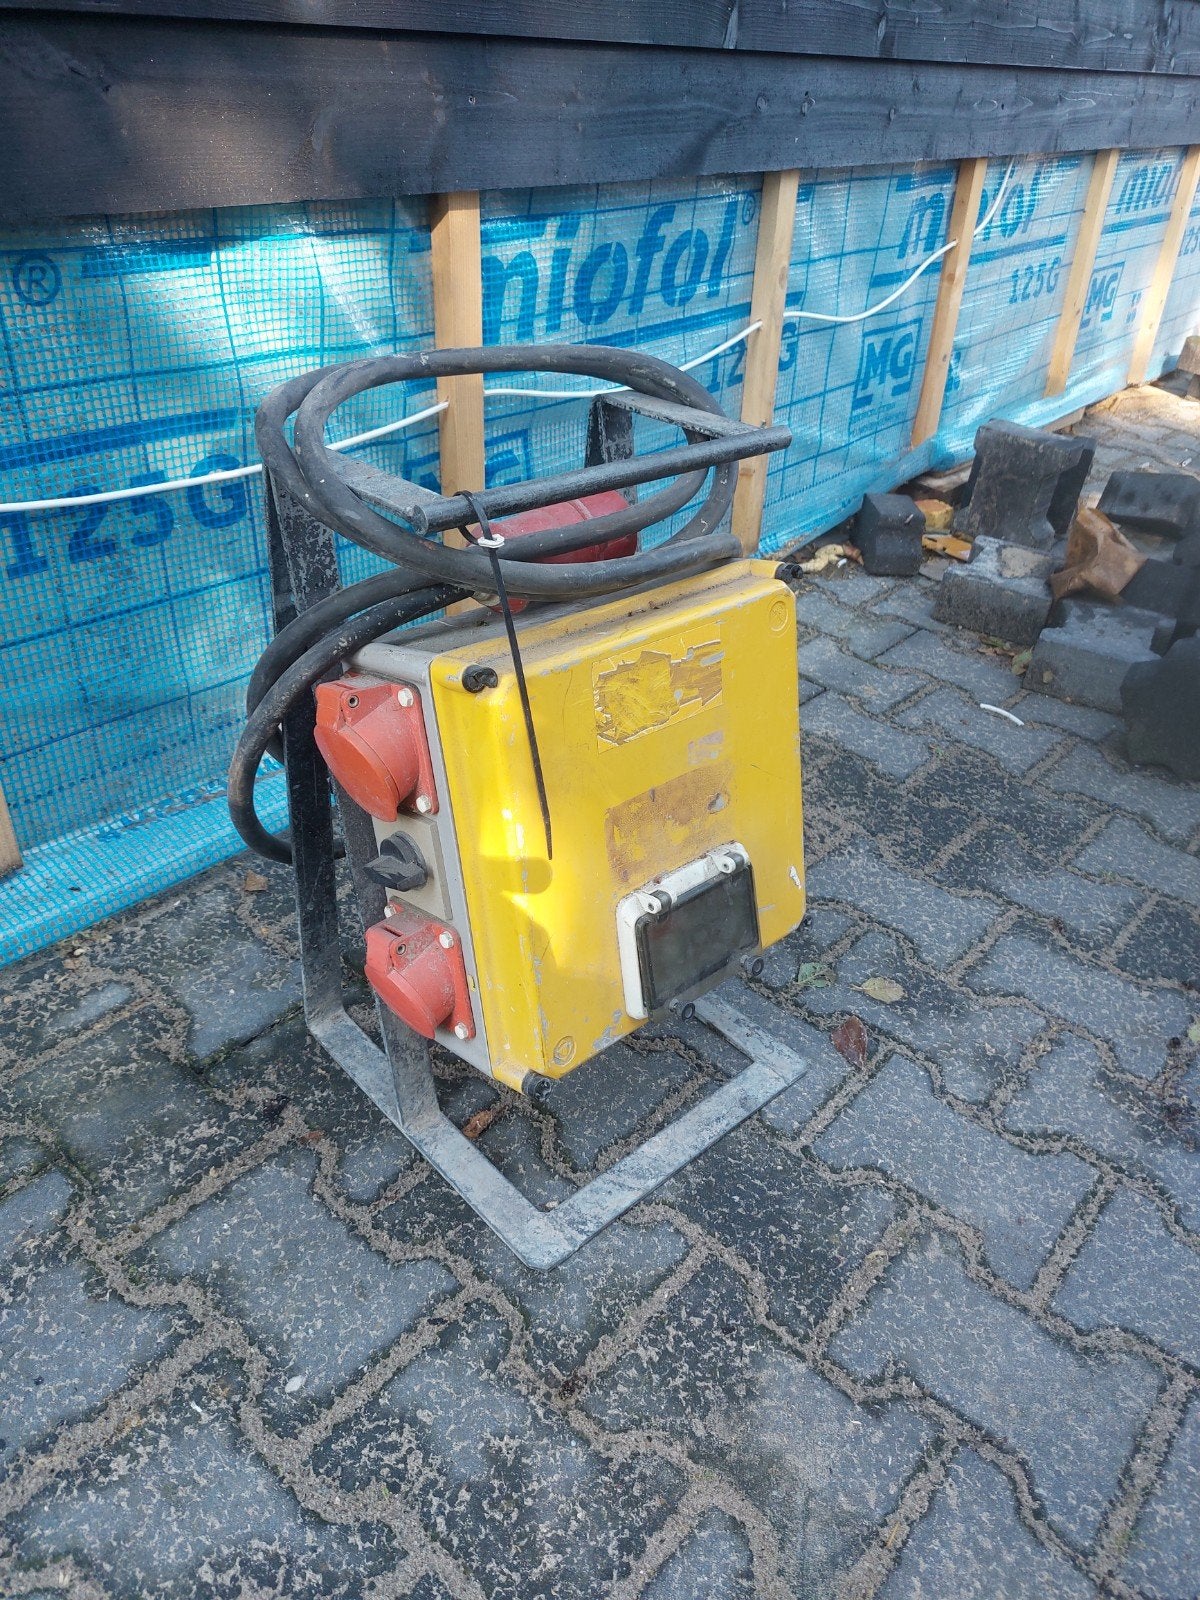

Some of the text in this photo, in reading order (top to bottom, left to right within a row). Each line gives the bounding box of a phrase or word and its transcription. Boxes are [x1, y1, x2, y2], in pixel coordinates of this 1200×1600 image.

[1009, 256, 1062, 304] 125G
[1086, 272, 1119, 315] MG
[705, 322, 797, 394] 12G
[860, 332, 914, 391] MG
[0, 453, 248, 581] 125G
